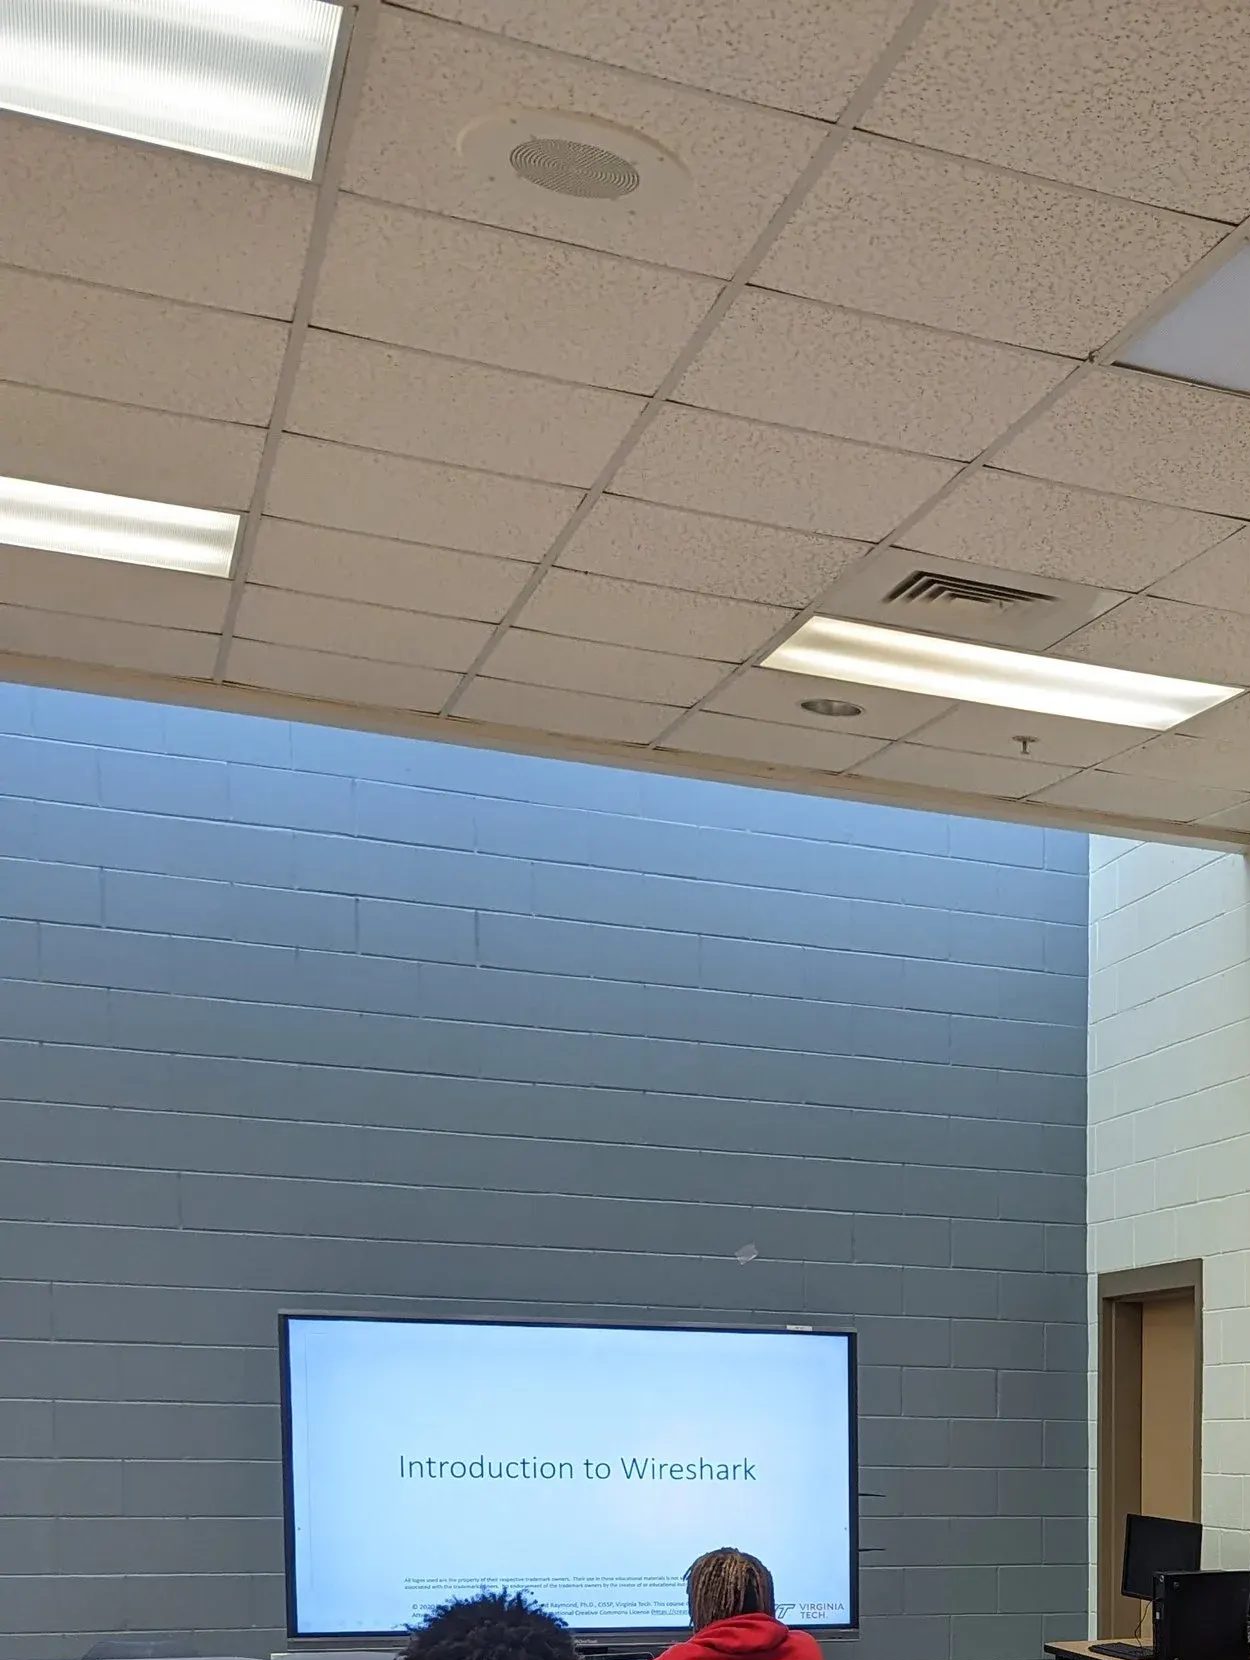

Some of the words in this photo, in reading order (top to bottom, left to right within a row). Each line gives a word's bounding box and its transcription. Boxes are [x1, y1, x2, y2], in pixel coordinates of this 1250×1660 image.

[400, 1454, 573, 1479] Introduction
[583, 1458, 611, 1480] to
[621, 1457, 756, 1480] Wireshark
[800, 1603, 845, 1612] VIRGINIA
